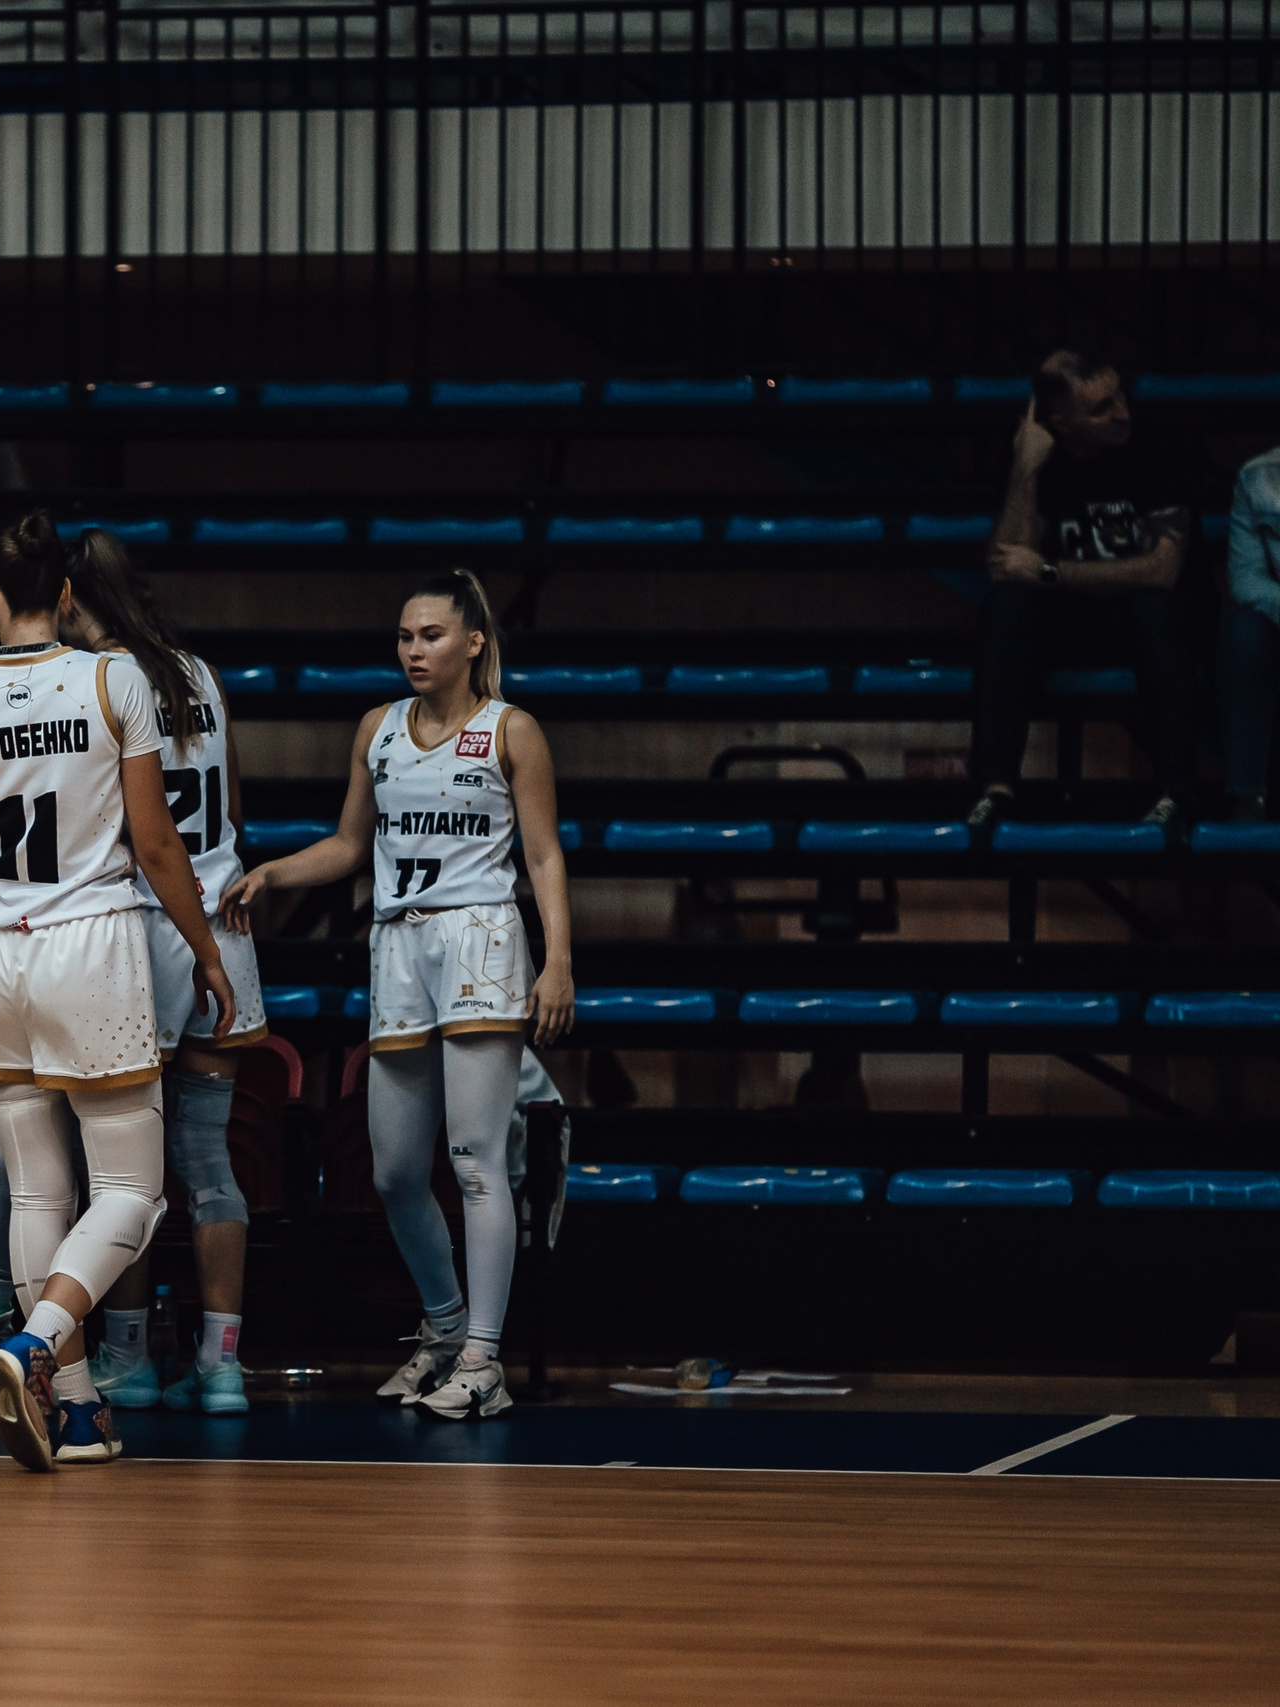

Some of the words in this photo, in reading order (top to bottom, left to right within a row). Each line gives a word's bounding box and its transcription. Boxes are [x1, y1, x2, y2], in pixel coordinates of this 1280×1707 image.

[10, 692, 29, 701] РФБ
[460, 733, 490, 744] FON
[458, 742, 488, 755] BET
[162, 765, 222, 855] 21
